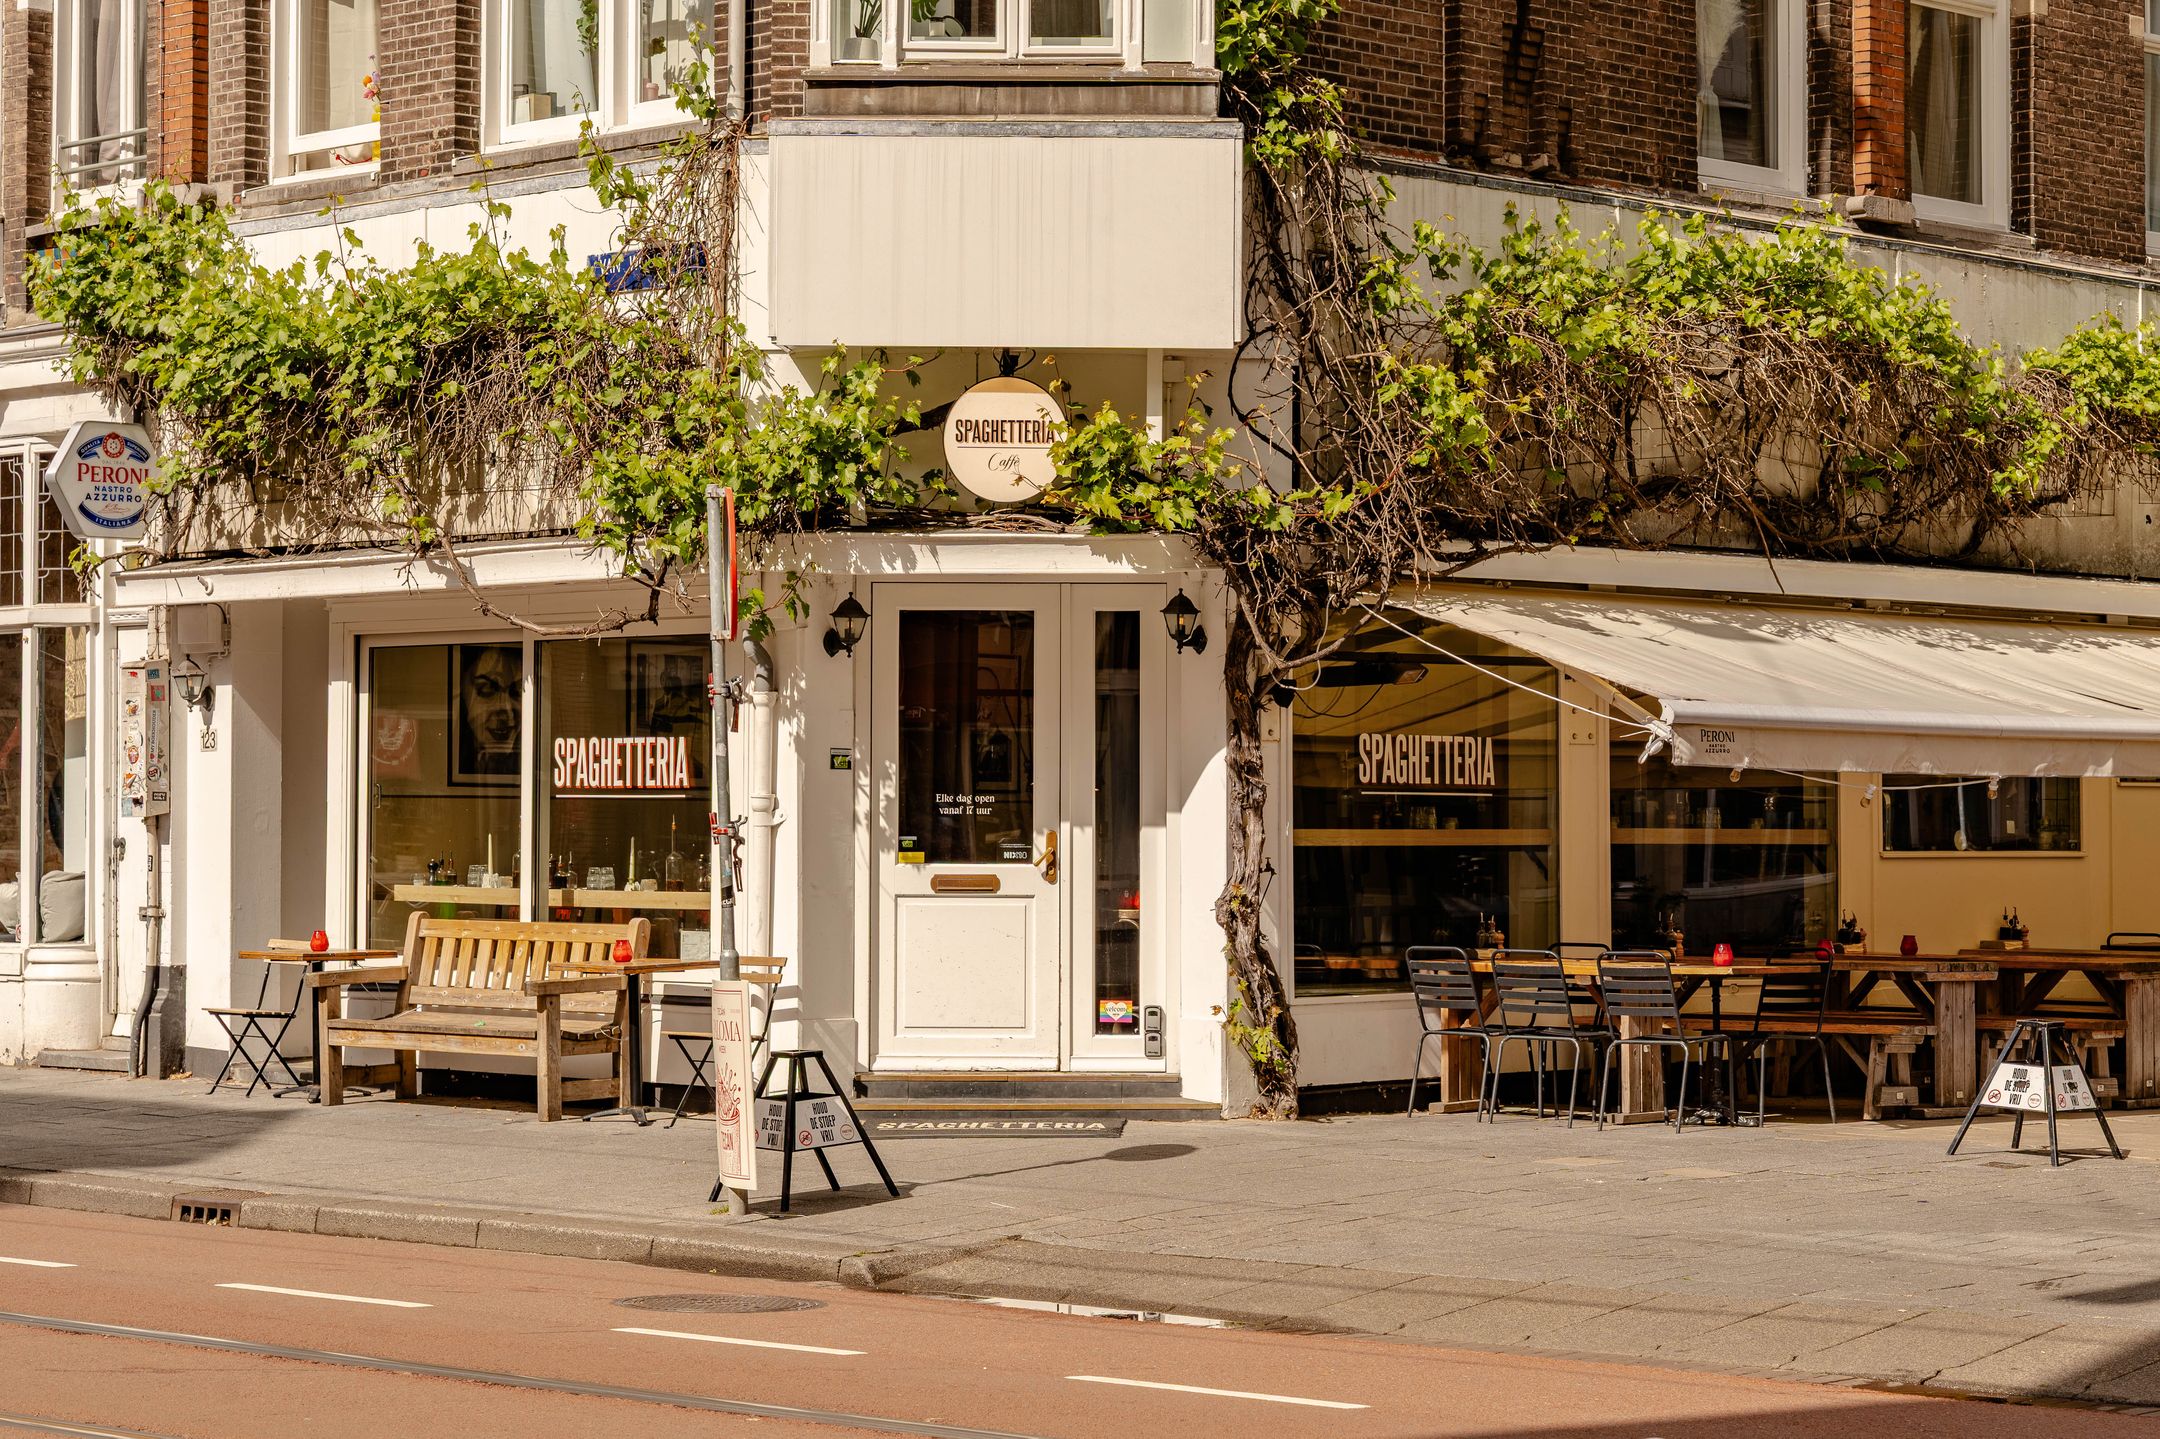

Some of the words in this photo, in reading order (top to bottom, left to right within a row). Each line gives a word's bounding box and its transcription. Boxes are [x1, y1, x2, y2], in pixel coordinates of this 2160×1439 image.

[955, 419, 1055, 444] SPAGHETTERIA
[77, 462, 150, 485] PERONI
[94, 485, 132, 493] NASTRO
[85, 492, 142, 503] AZZURRO
[95, 517, 132, 527] ITALIANA
[201, 731, 216, 749] 123
[1700, 729, 1735, 743] PERONI
[554, 736, 690, 789] SPAGHETTERIA
[1358, 733, 1496, 786] SPAGHETTERIA
[935, 793, 954, 802] Elke
[956, 793, 973, 805] dag
[974, 795, 995, 805] open
[938, 805, 964, 814] vanaf
[966, 805, 974, 815] 17
[976, 807, 992, 815] uur
[2012, 1068, 2028, 1079] HOUD
[2005, 1080, 2012, 1091] DE
[2009, 1093, 2021, 1105] VRIJ
[811, 1101, 829, 1115] HOUD
[761, 1117, 769, 1130] DE
[810, 1117, 818, 1129] DE
[818, 1114, 836, 1129] STOEP
[877, 1122, 1106, 1131] SPAGHETTERIA
[820, 1129, 835, 1143] VRIJ
